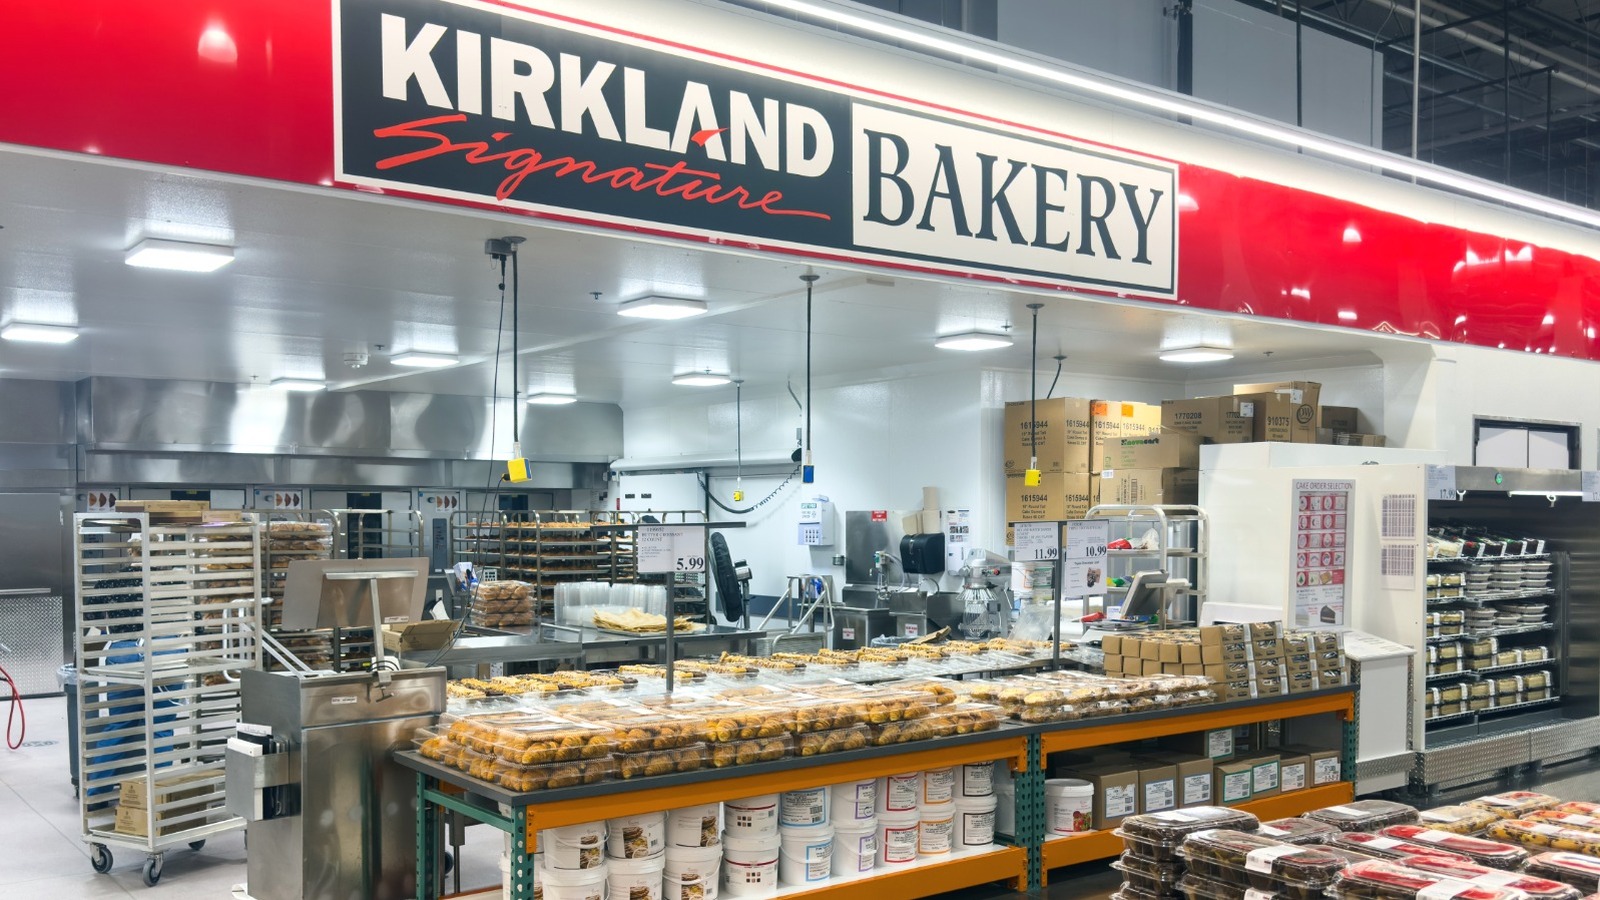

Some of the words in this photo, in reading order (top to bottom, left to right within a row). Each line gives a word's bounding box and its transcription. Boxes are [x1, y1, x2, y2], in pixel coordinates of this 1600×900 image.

[381, 13, 834, 178] KIRKLAND
[374, 114, 831, 220] Signature
[863, 128, 1164, 265] BAKERY
[1175, 412, 1202, 420] 1770208
[1267, 416, 1289, 426] 910375
[1066, 420, 1090, 428] 1615944
[1095, 420, 1120, 429] 1615944
[1035, 548, 1057, 559] 11.99
[1086, 546, 1106, 557] 10.99
[676, 557, 704, 570] 5.99
